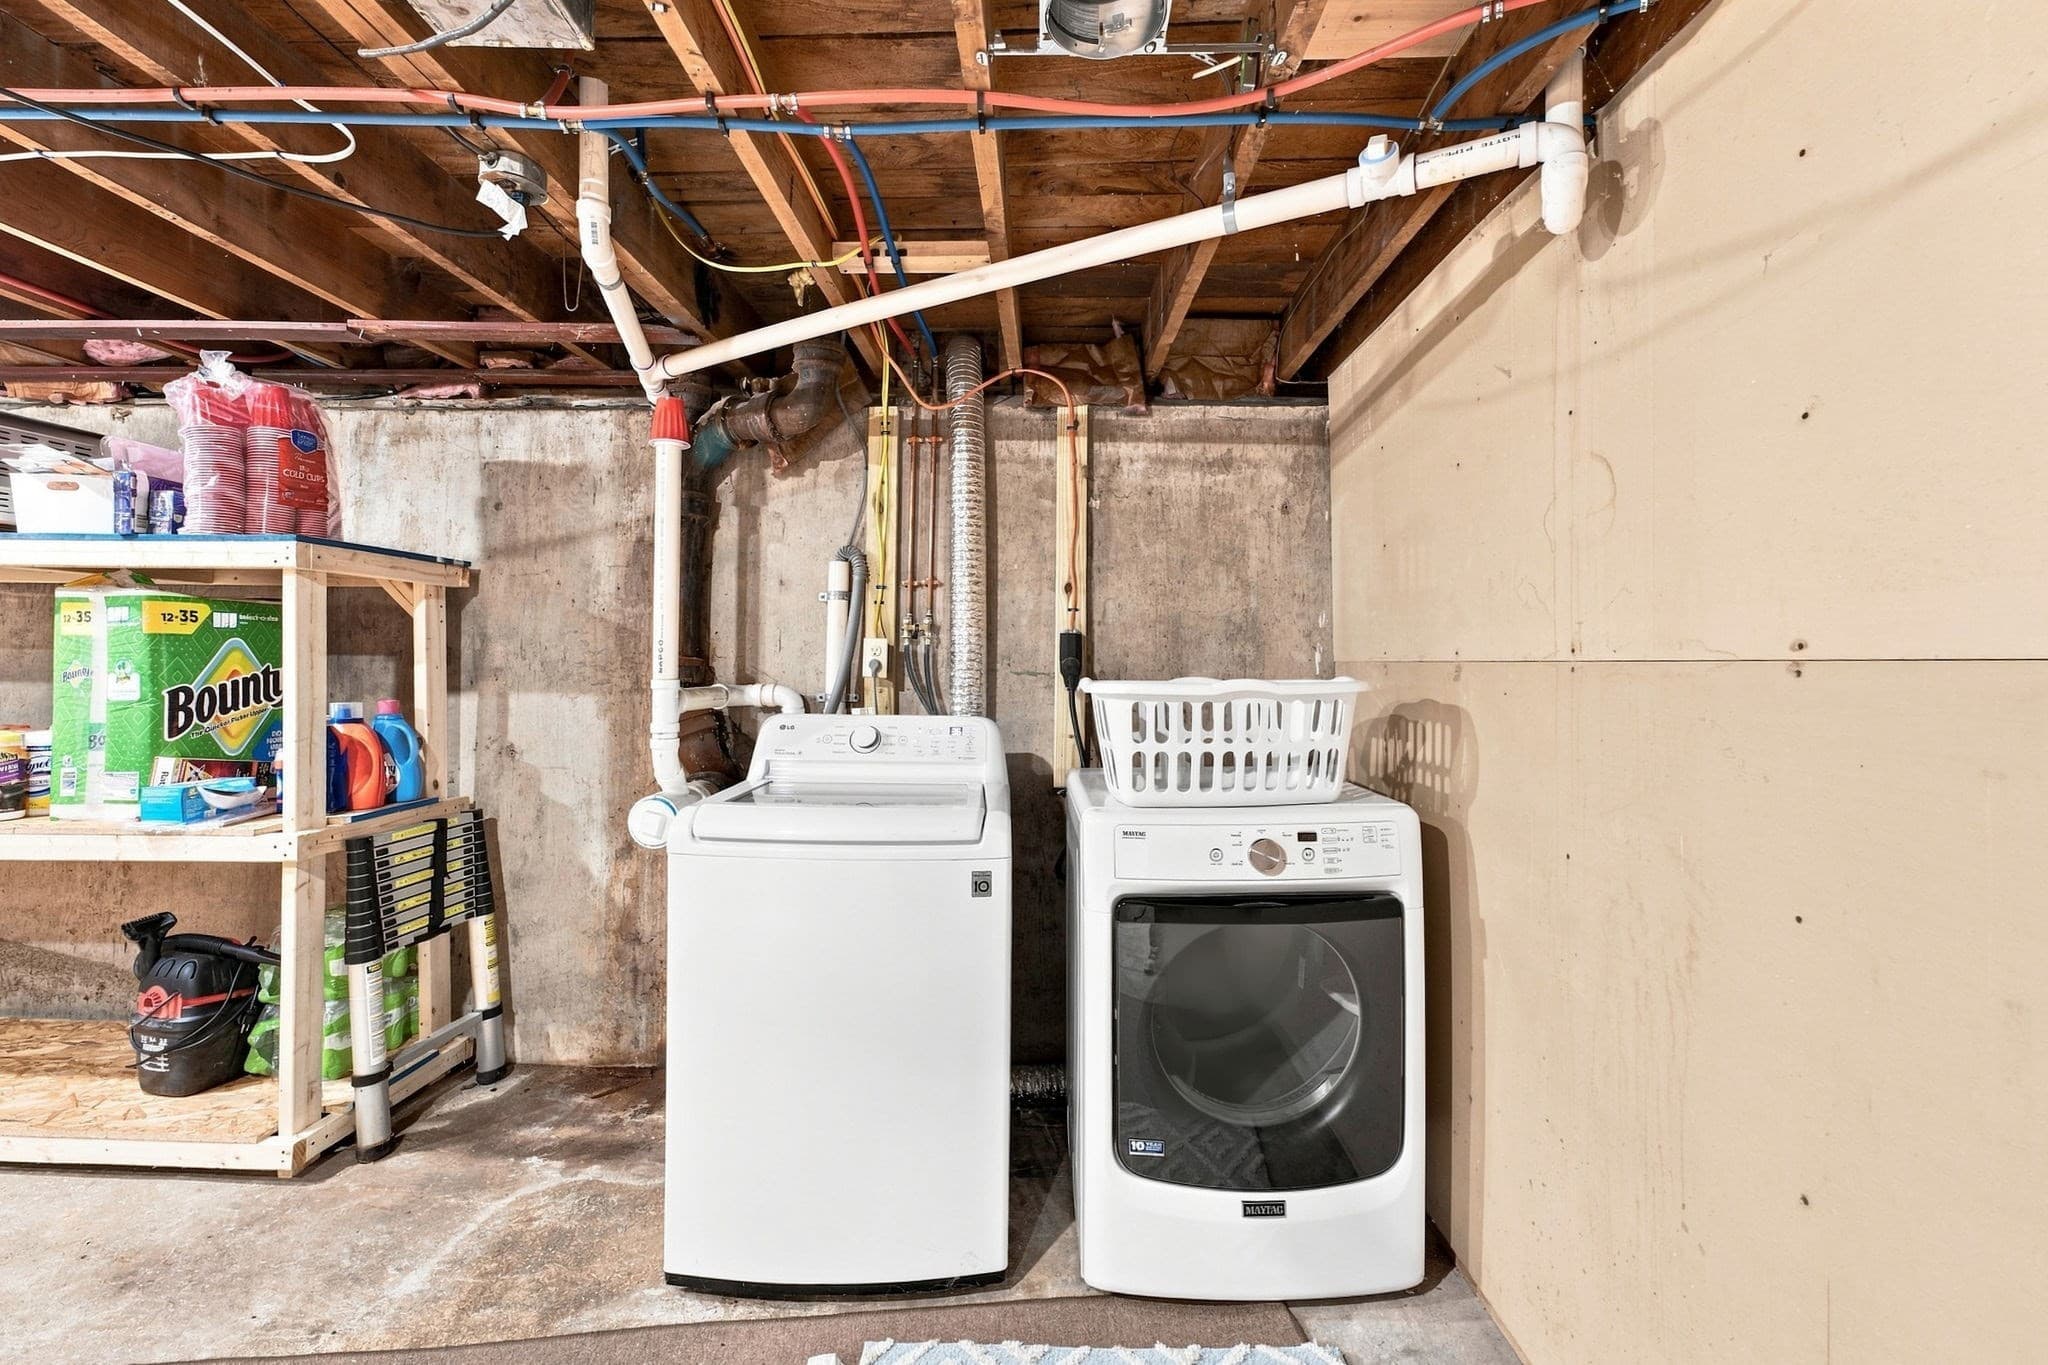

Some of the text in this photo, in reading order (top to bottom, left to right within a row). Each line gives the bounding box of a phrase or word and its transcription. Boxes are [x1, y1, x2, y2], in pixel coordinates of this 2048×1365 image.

[283, 469, 305, 480] COLD
[1131, 1141, 1145, 1151] 10
[1245, 1205, 1284, 1216] MAYTAG
